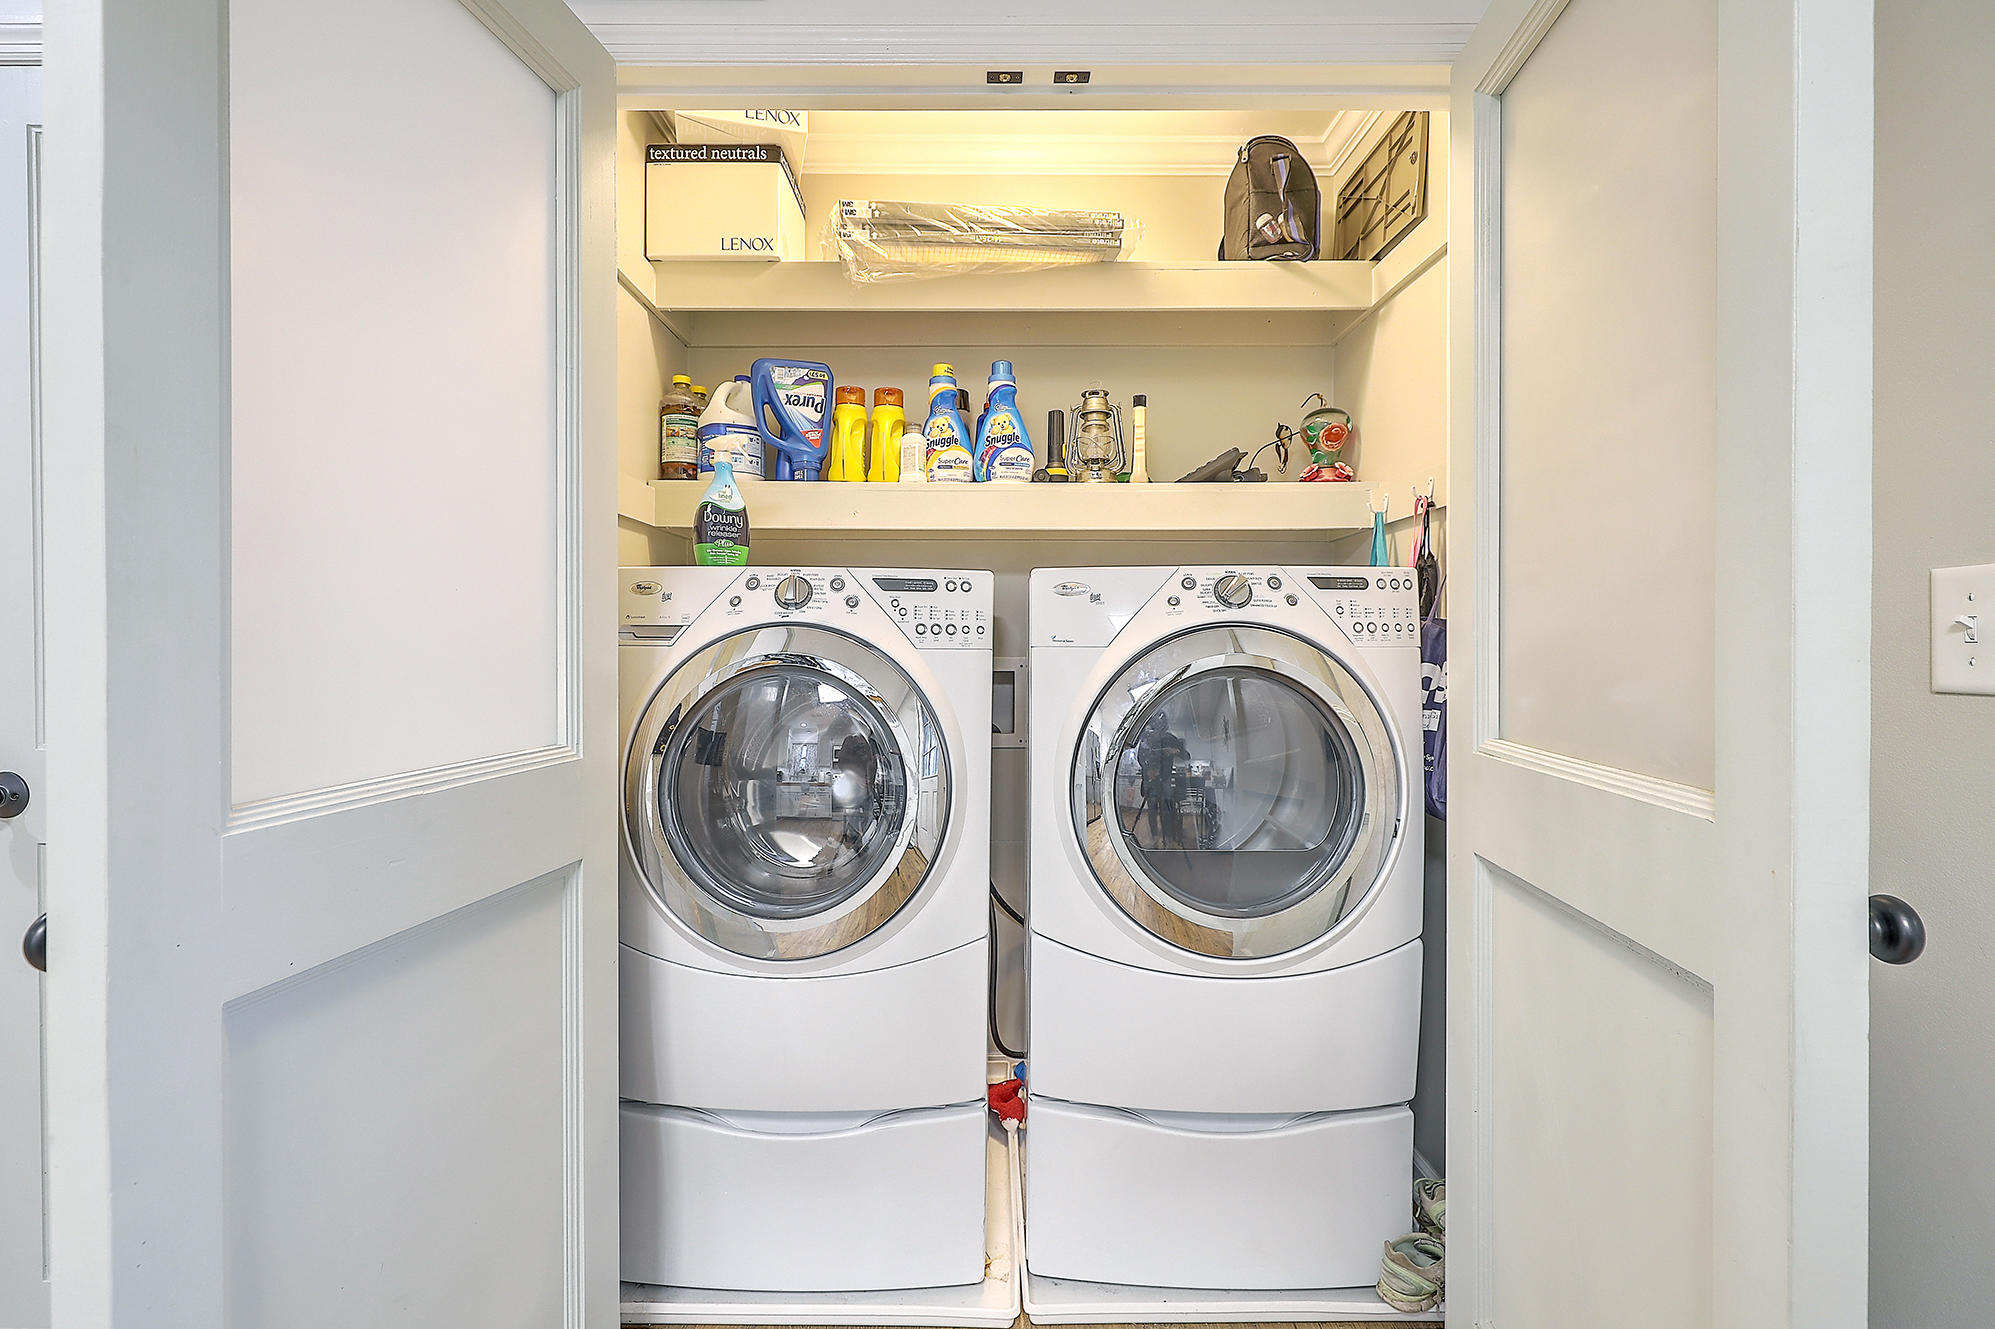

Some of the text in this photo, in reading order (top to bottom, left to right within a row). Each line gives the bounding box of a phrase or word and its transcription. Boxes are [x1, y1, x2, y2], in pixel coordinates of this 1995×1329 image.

[745, 110, 801, 127] LENOX
[649, 145, 767, 160] textured neutrals
[720, 237, 774, 251] LENOX
[784, 393, 825, 414] Purex
[985, 432, 1021, 447] Snuggle
[703, 509, 744, 529] Downy
